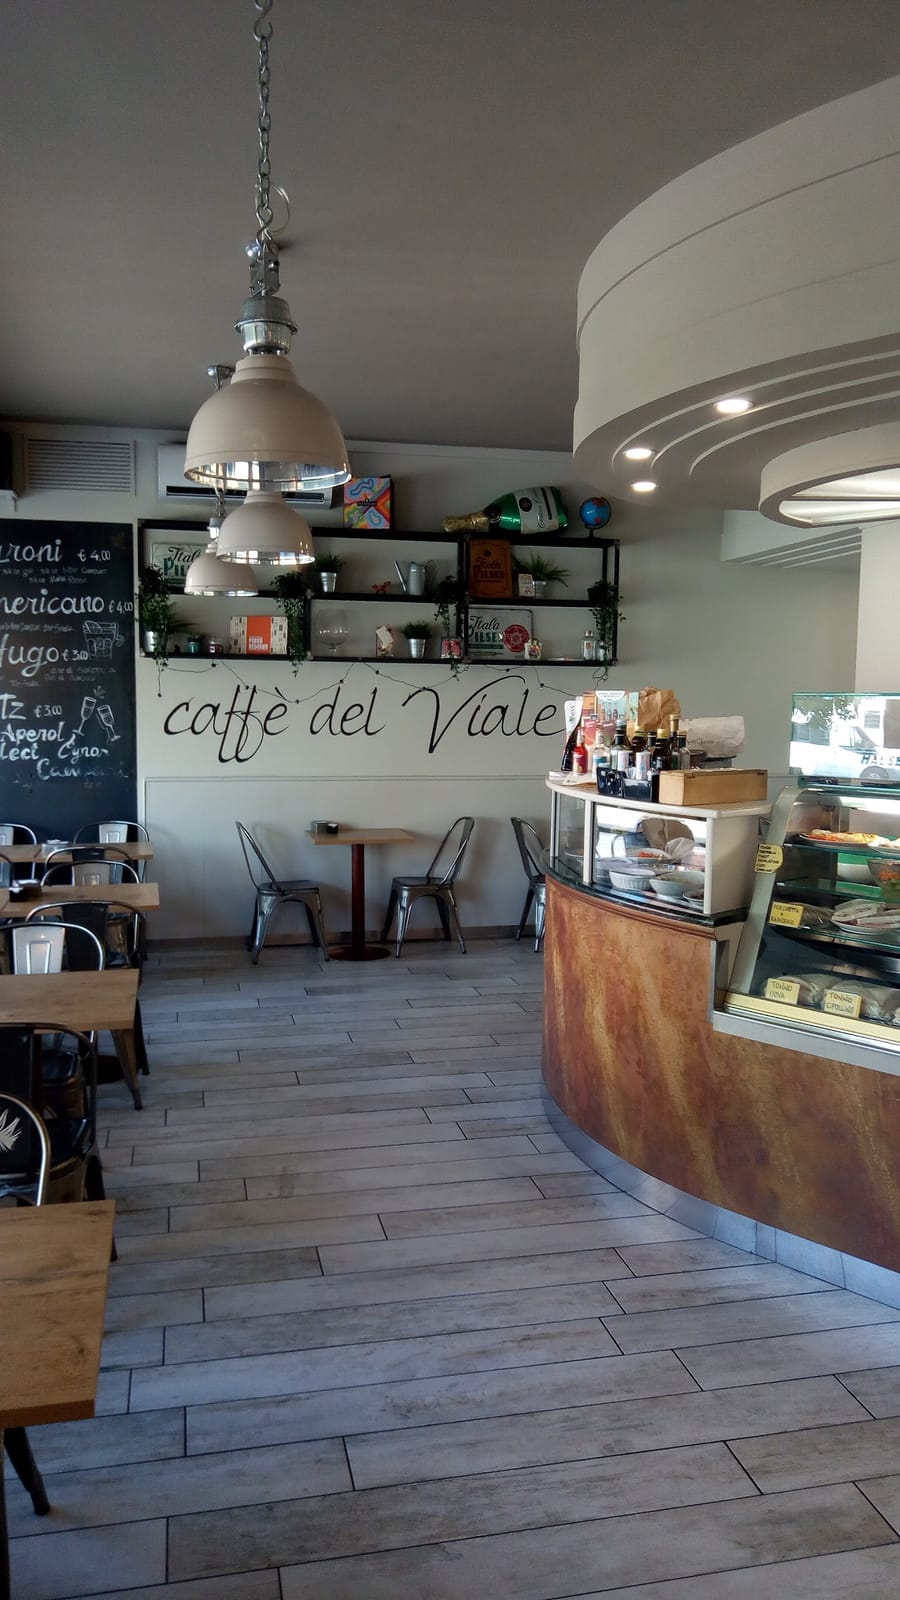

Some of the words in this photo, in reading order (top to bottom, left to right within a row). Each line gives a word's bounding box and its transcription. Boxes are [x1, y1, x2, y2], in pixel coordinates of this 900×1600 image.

[163, 684, 289, 763] caffè
[309, 686, 387, 736] del
[401, 674, 567, 754] Viale
[770, 981, 793, 993] TONNO
[828, 991, 854, 1004] TONNO
